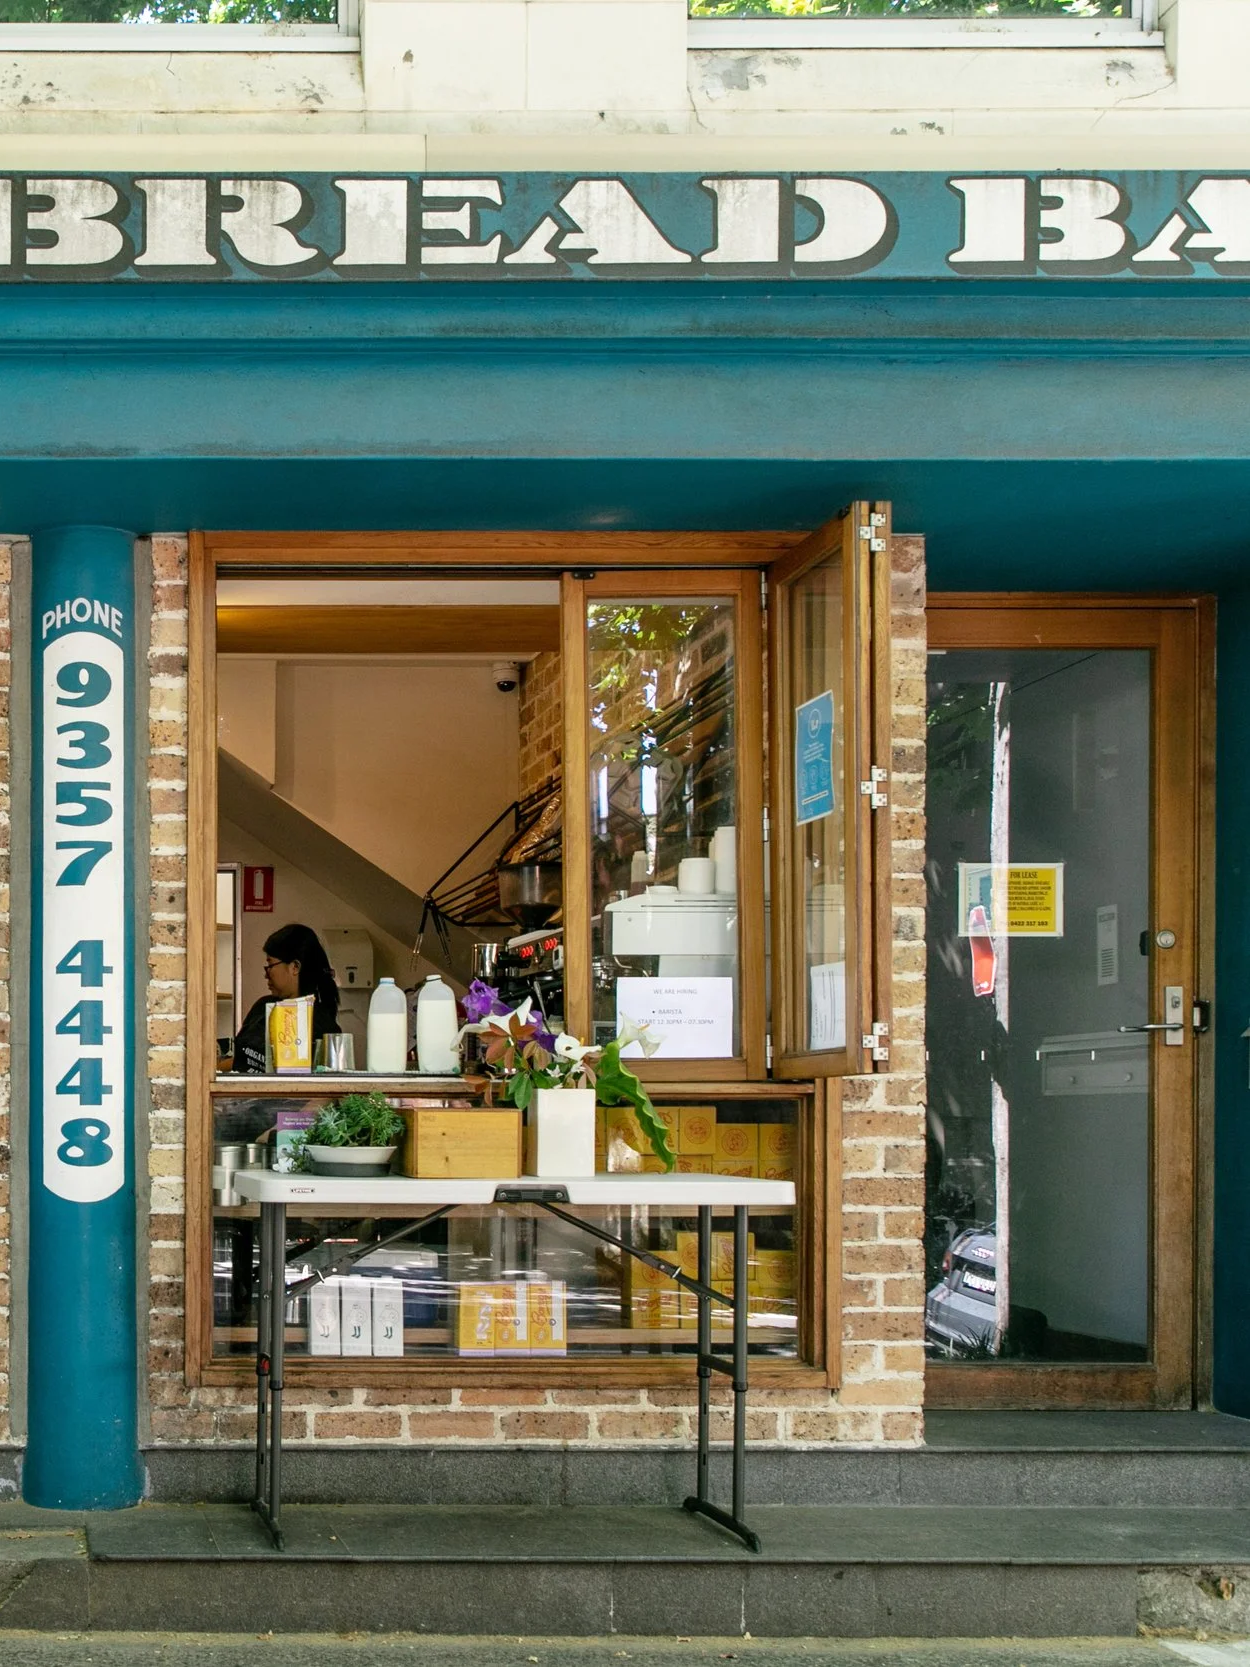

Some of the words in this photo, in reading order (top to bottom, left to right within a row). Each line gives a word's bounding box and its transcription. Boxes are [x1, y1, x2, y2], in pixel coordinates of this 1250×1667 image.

[41, 597, 124, 640] PHONE
[55, 660, 113, 887] 9357
[1021, 871, 1038, 879] LEASE
[55, 939, 114, 1168] 4448
